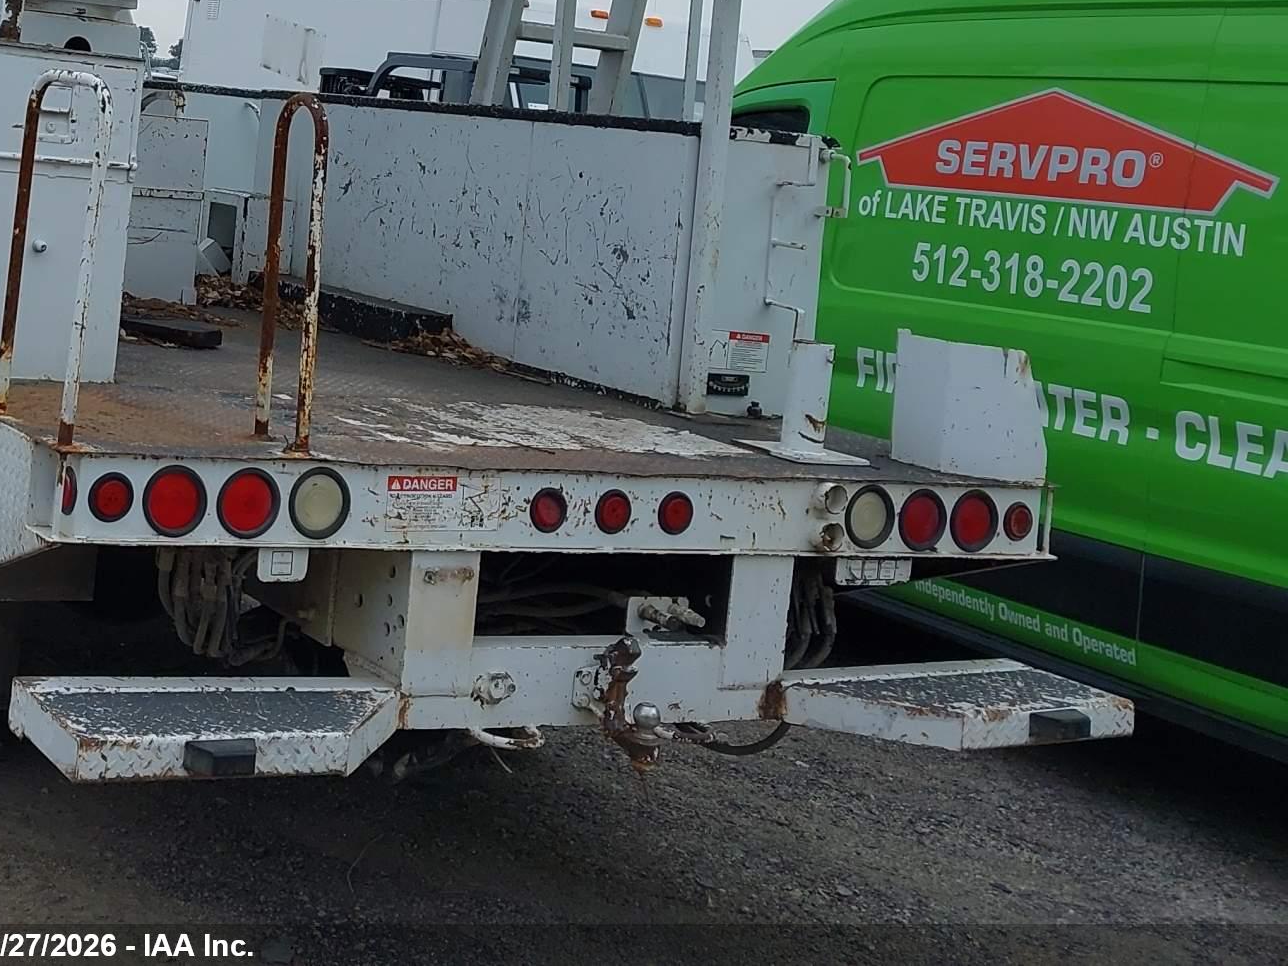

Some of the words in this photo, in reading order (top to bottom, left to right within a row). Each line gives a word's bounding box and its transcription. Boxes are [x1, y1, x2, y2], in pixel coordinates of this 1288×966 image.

[859, 190, 882, 217] of
[885, 191, 947, 224] LAKE
[955, 197, 1046, 234] TRAVIS
[1067, 208, 1123, 241] NW
[1123, 214, 1246, 256] AUSTIN
[912, 241, 1153, 314] 512-318-2202
[403, 478, 454, 490] DANGER
[999, 603, 1040, 632] Owned
[1045, 623, 1068, 642] and
[1073, 628, 1137, 666] Operated
